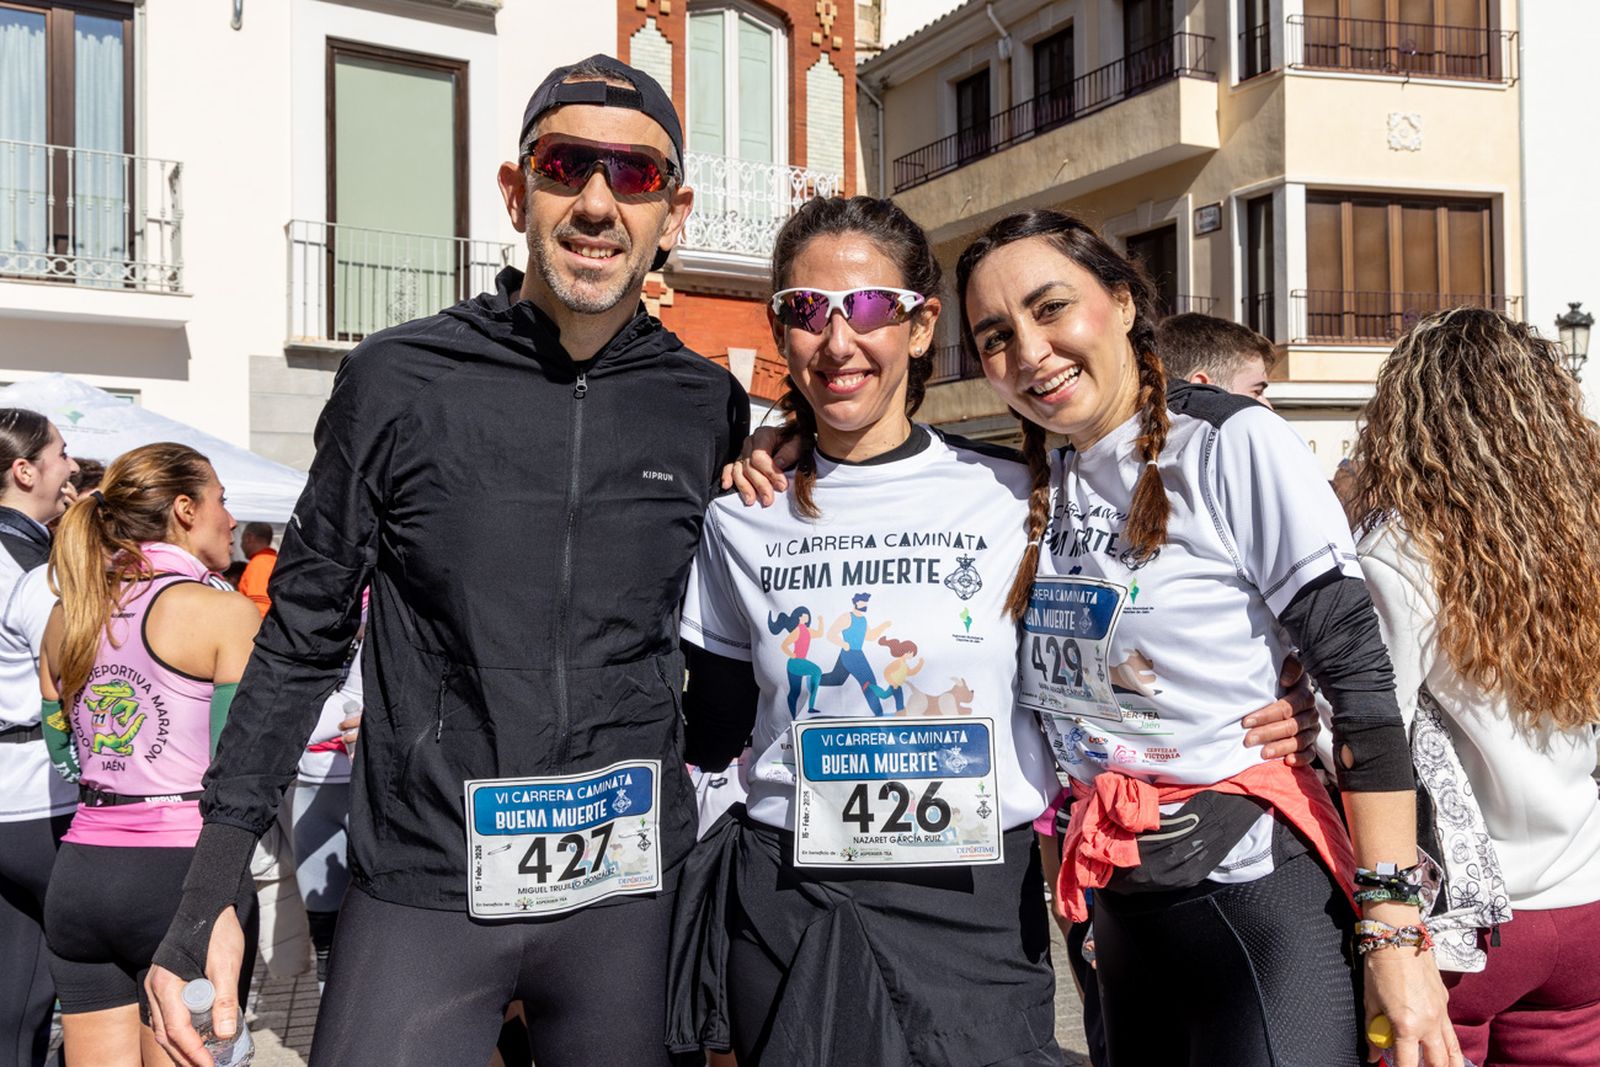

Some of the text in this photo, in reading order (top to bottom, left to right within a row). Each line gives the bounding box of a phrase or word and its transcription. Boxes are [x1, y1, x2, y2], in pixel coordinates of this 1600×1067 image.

[643, 470, 673, 481] KIPRUN
[766, 532, 988, 557] VI CARRERA CAMINATA
[760, 558, 941, 593] BUENA MUERTE
[1043, 608, 1076, 630] MUERTE
[1032, 636, 1083, 687] 429
[93, 713, 106, 724] 71
[144, 695, 170, 764] MARATON
[821, 730, 968, 747] VI CARRERA CAMINATA
[102, 761, 126, 772] JAÉN
[822, 751, 938, 775] BUENA MUERTE
[495, 773, 633, 804] VI CARRERA CAMINATA
[495, 799, 607, 830] BUENA MUERTE
[842, 781, 951, 834] 426
[853, 833, 942, 844] NAZARET GARCÍA RUIZ
[518, 822, 615, 884] 427
[518, 887, 548, 895] MIGUEL
